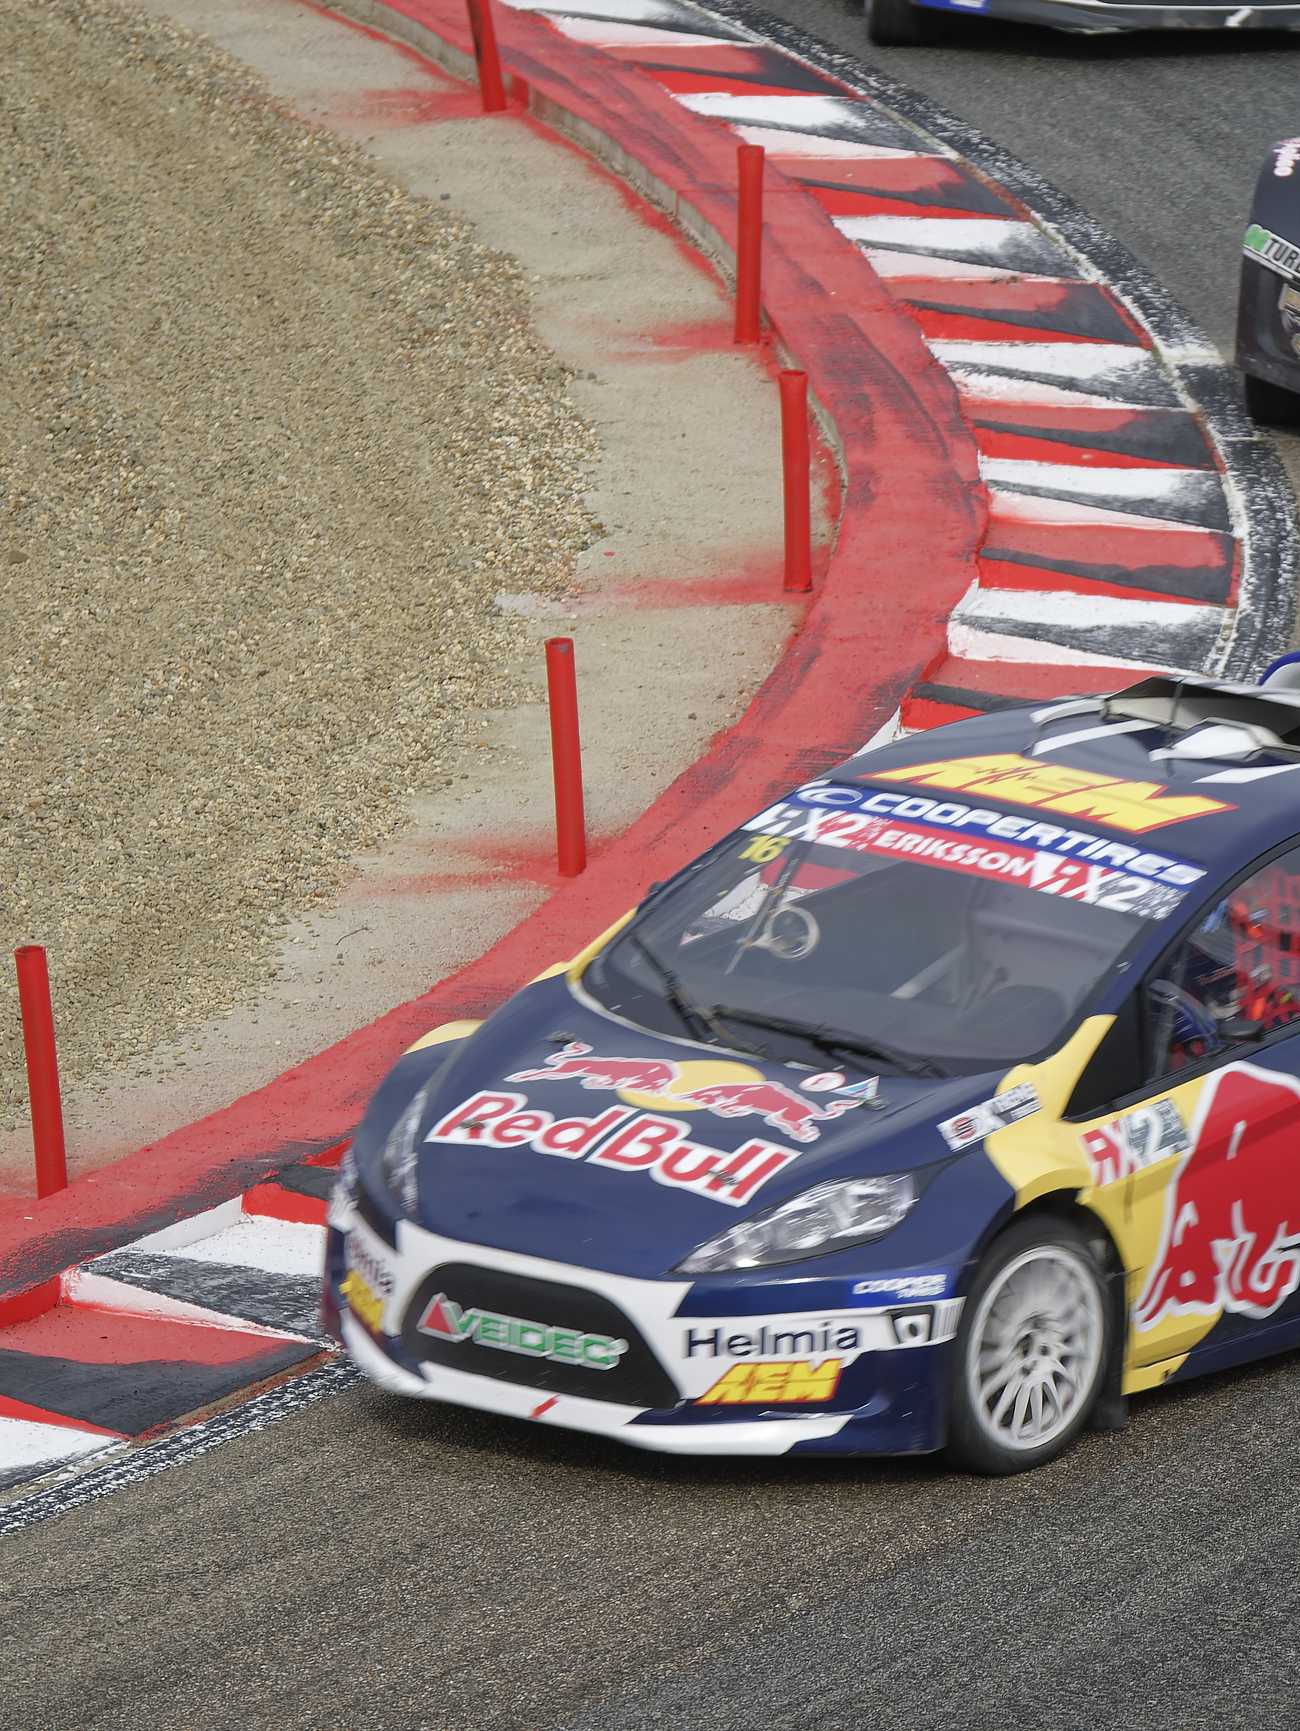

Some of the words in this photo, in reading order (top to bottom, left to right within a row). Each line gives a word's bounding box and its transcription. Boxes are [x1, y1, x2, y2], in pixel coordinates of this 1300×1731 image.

[737, 834, 790, 864] 16
[876, 828, 1032, 876] ERIKSSON
[424, 1090, 640, 1159] Red
[584, 1113, 802, 1208] Bull
[455, 1306, 621, 1370] VEIDEC
[683, 1321, 859, 1358] Helmia
[692, 1357, 844, 1406] AEM
